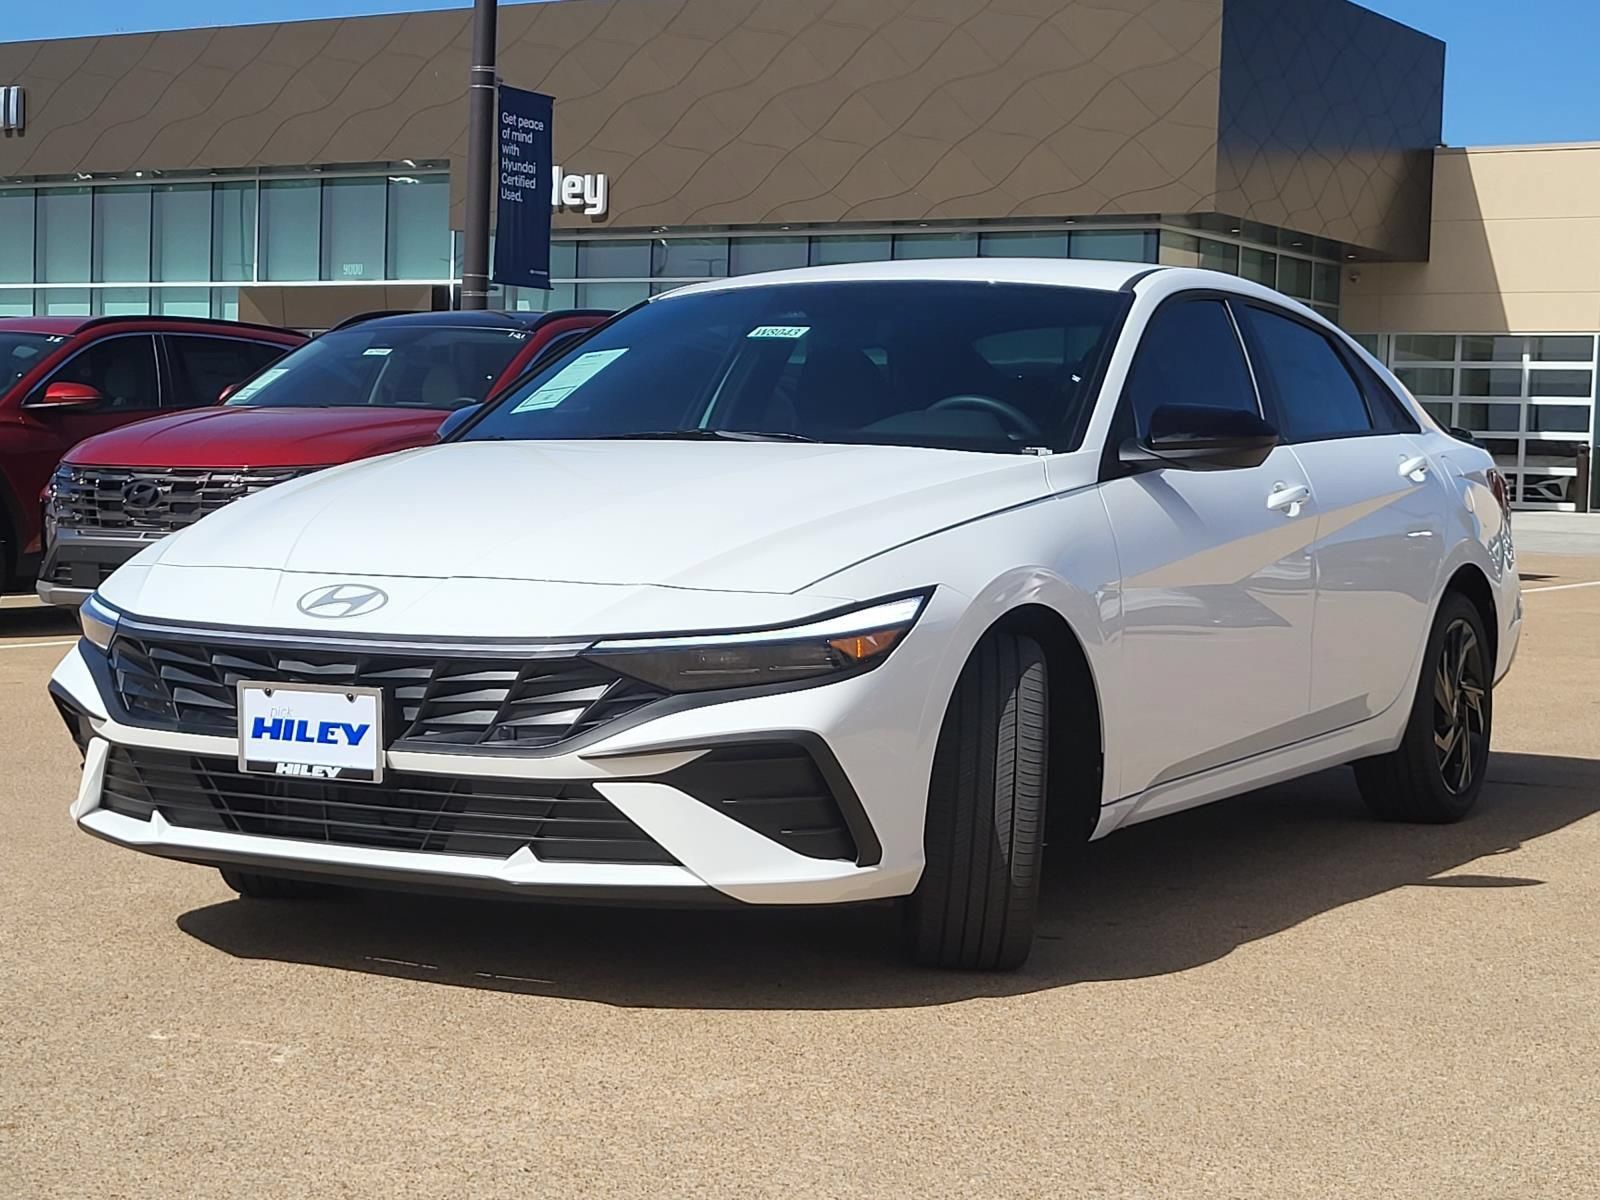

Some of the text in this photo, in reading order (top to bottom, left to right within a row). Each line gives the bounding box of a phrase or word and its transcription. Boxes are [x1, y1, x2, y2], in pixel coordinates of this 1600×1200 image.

[502, 112, 544, 131] Get peace
[502, 128, 533, 143] of mind
[502, 143, 520, 156] with
[502, 157, 536, 174] Hyundai
[501, 173, 536, 189] Certified
[501, 188, 523, 202] Used.
[251, 716, 371, 747] HILEY
[275, 762, 342, 778] HILEY
